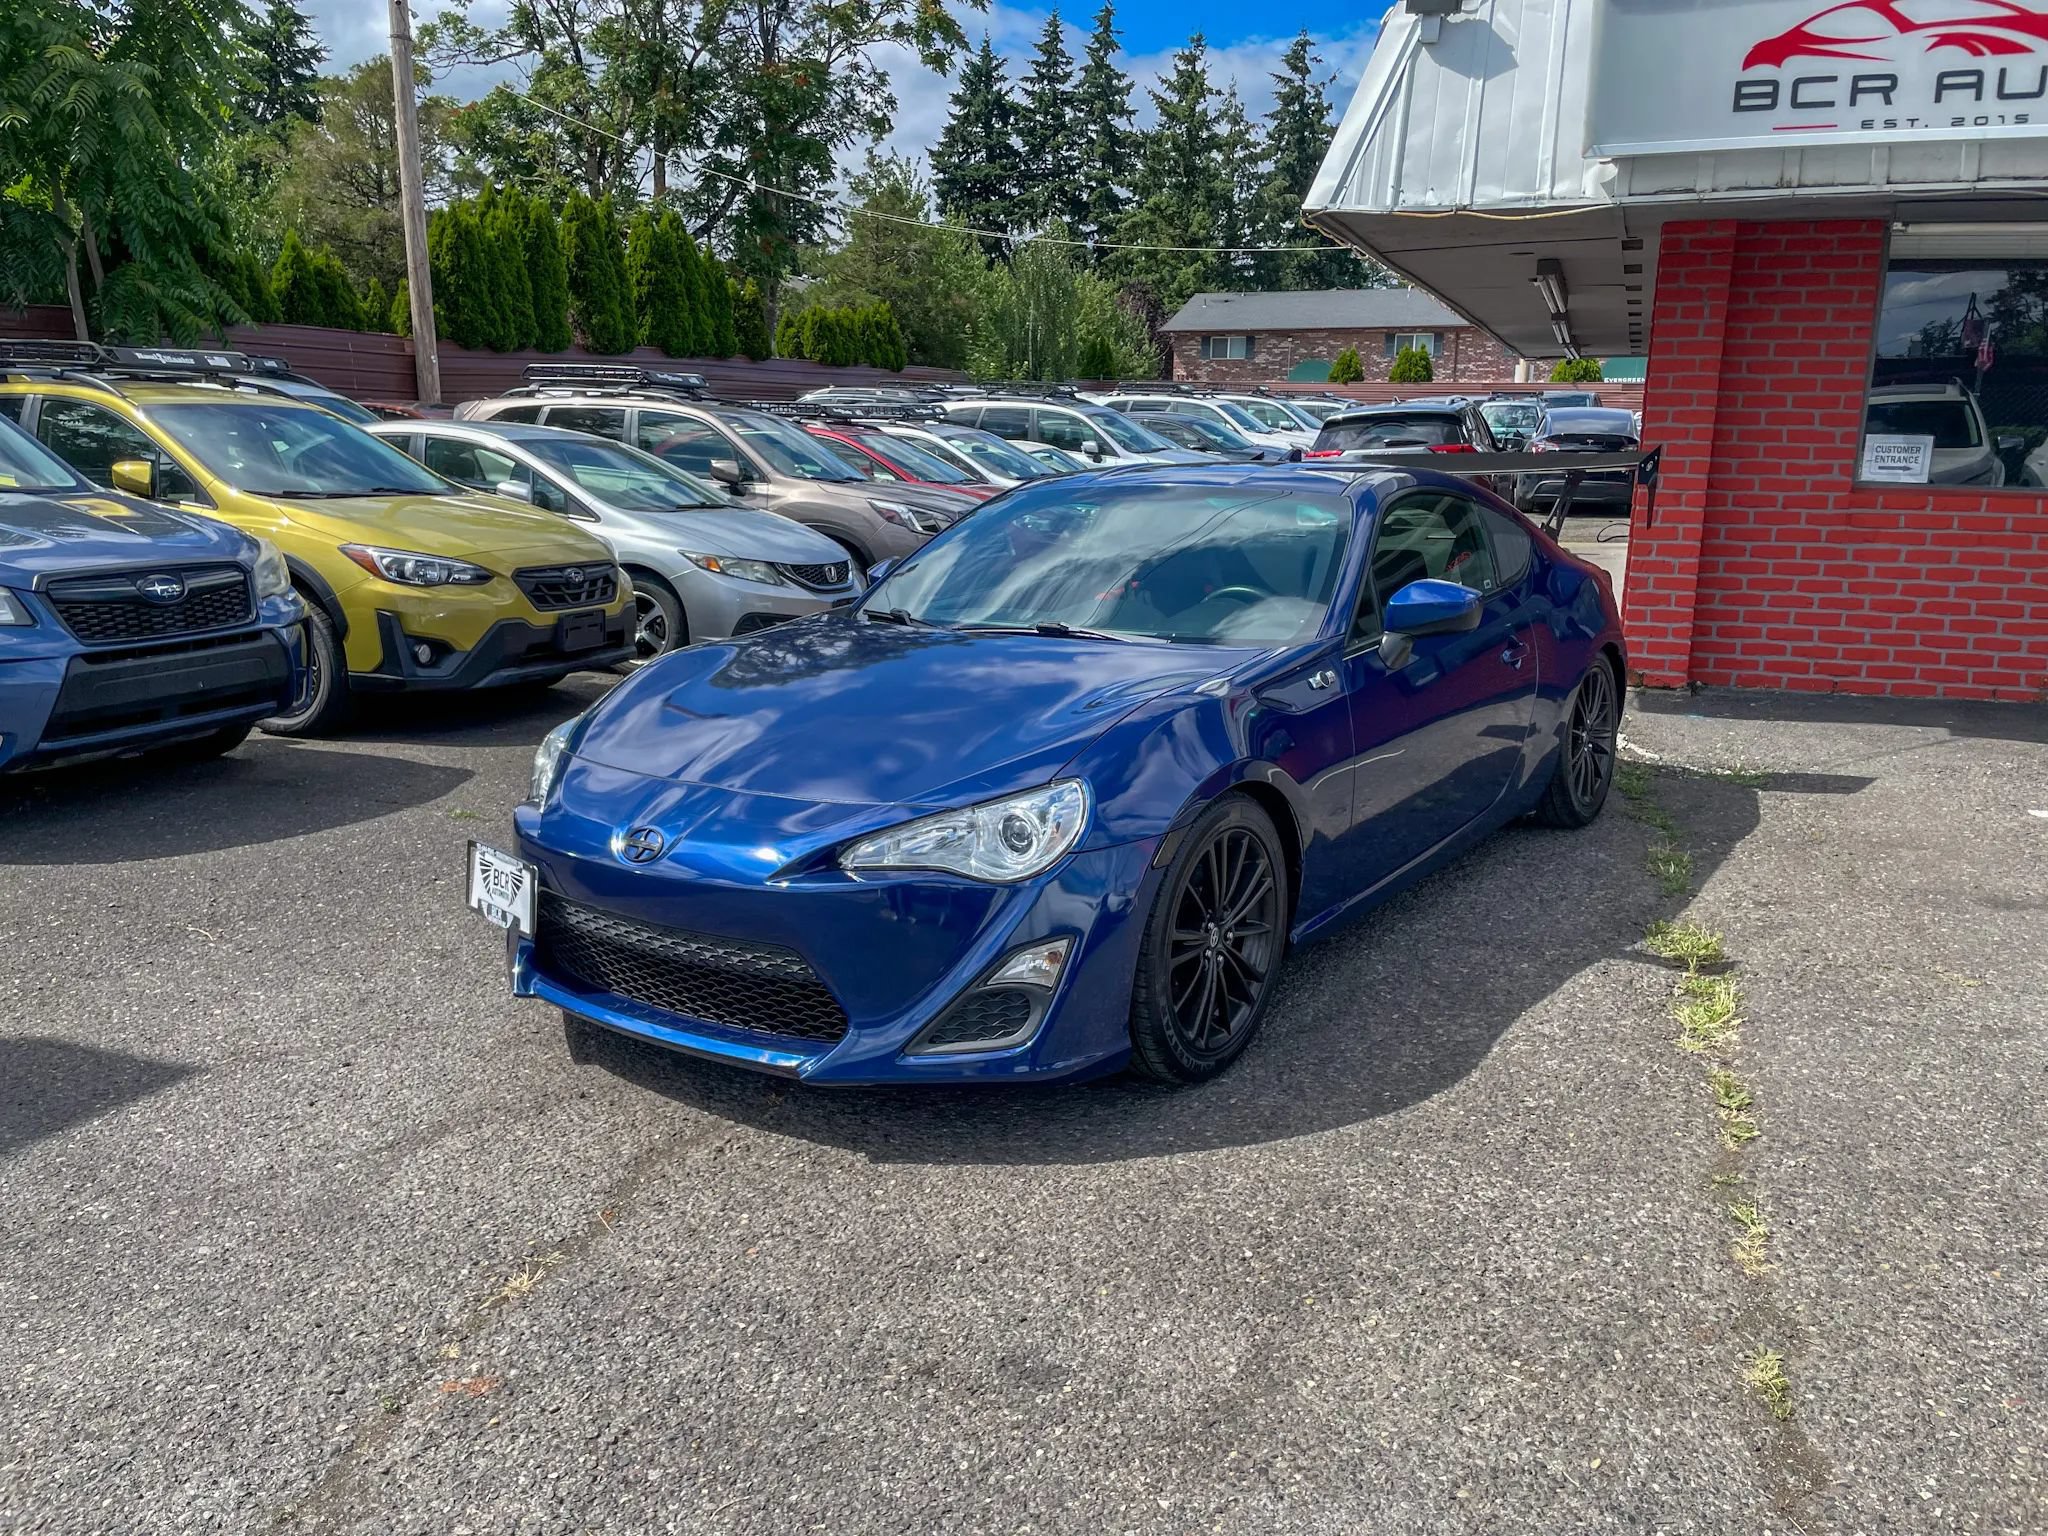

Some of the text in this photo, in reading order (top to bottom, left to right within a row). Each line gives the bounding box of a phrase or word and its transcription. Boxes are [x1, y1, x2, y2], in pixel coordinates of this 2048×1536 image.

[1733, 73, 1898, 112] BCR
[1860, 113, 2031, 129] EST. 2015
[1875, 445, 1921, 454] CUSTOMER
[1874, 455, 1920, 464] ENTRANCE
